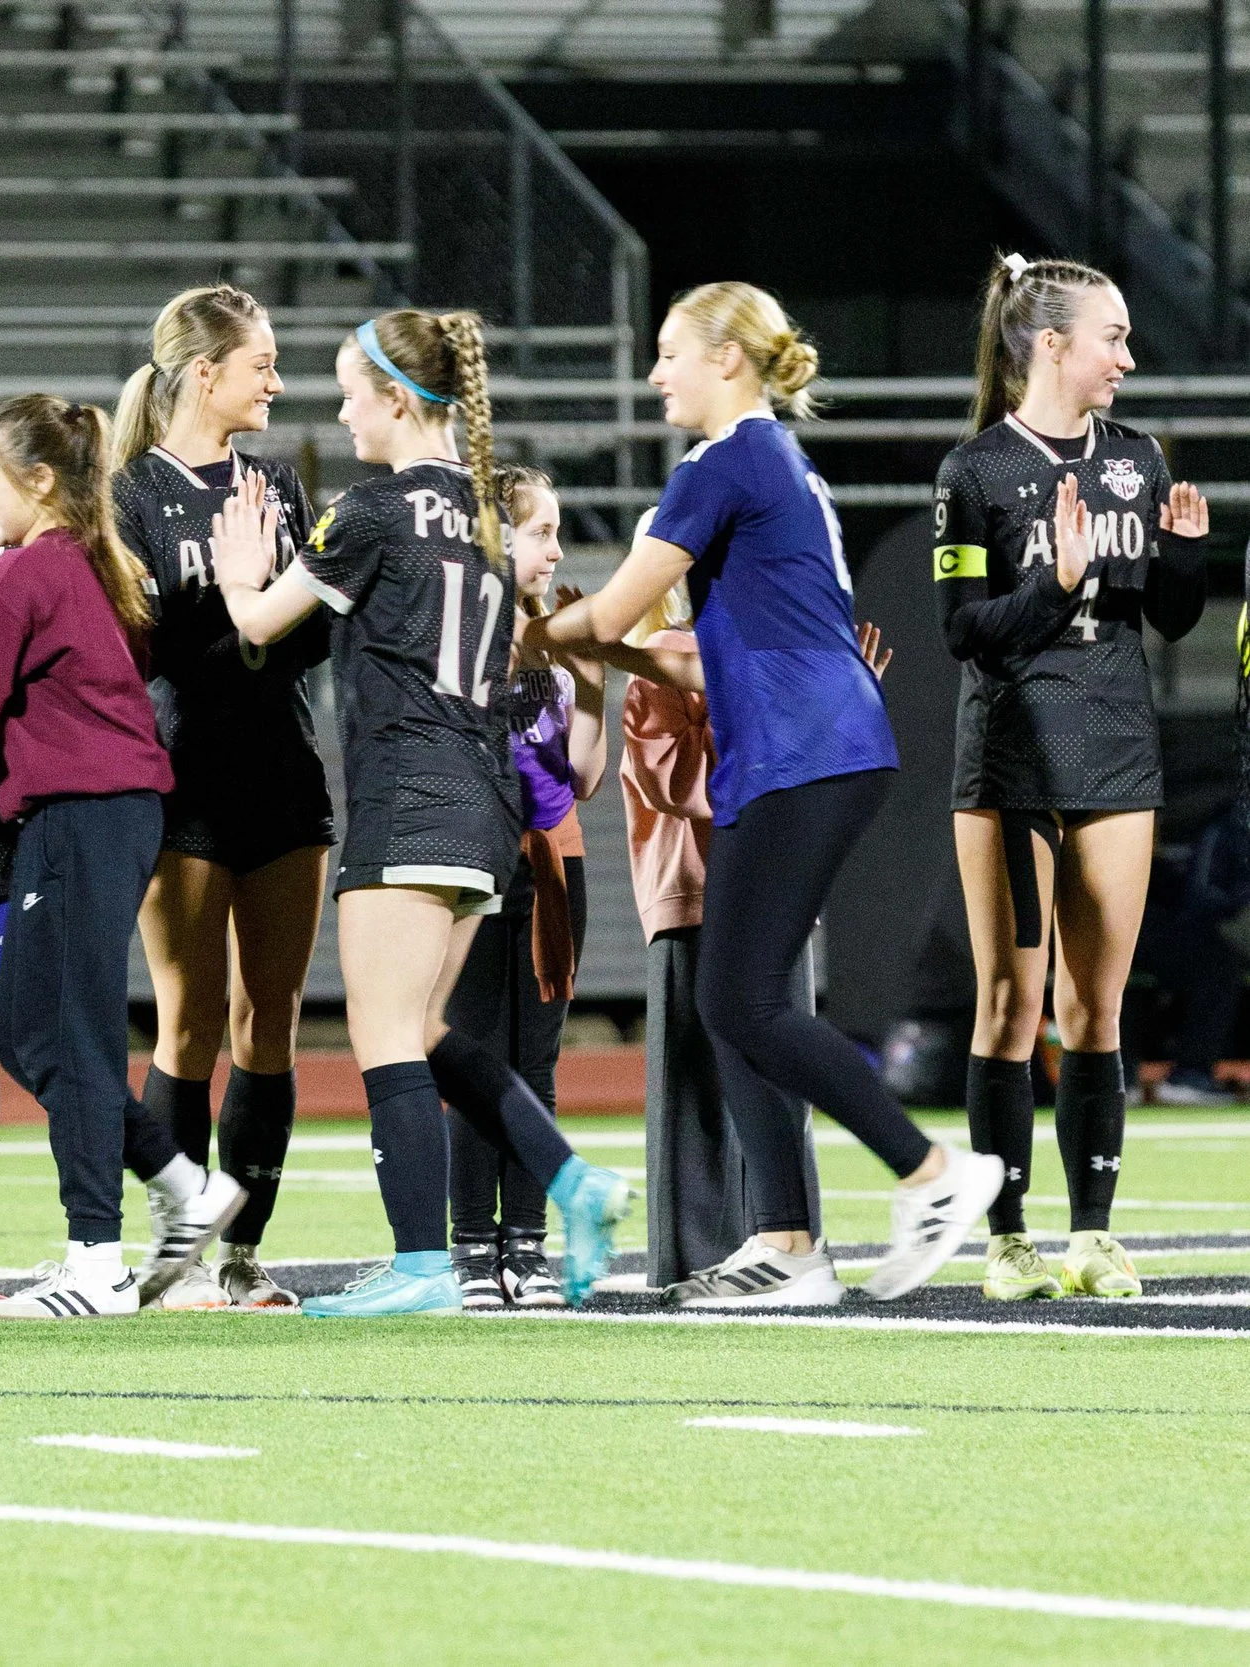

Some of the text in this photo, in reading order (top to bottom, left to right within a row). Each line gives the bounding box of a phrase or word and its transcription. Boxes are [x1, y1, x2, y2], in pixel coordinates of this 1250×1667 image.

[934, 502, 948, 539] 9
[1022, 510, 1144, 568] AMO
[939, 549, 959, 574] C
[431, 560, 504, 708] 12
[1070, 577, 1100, 641] 4
